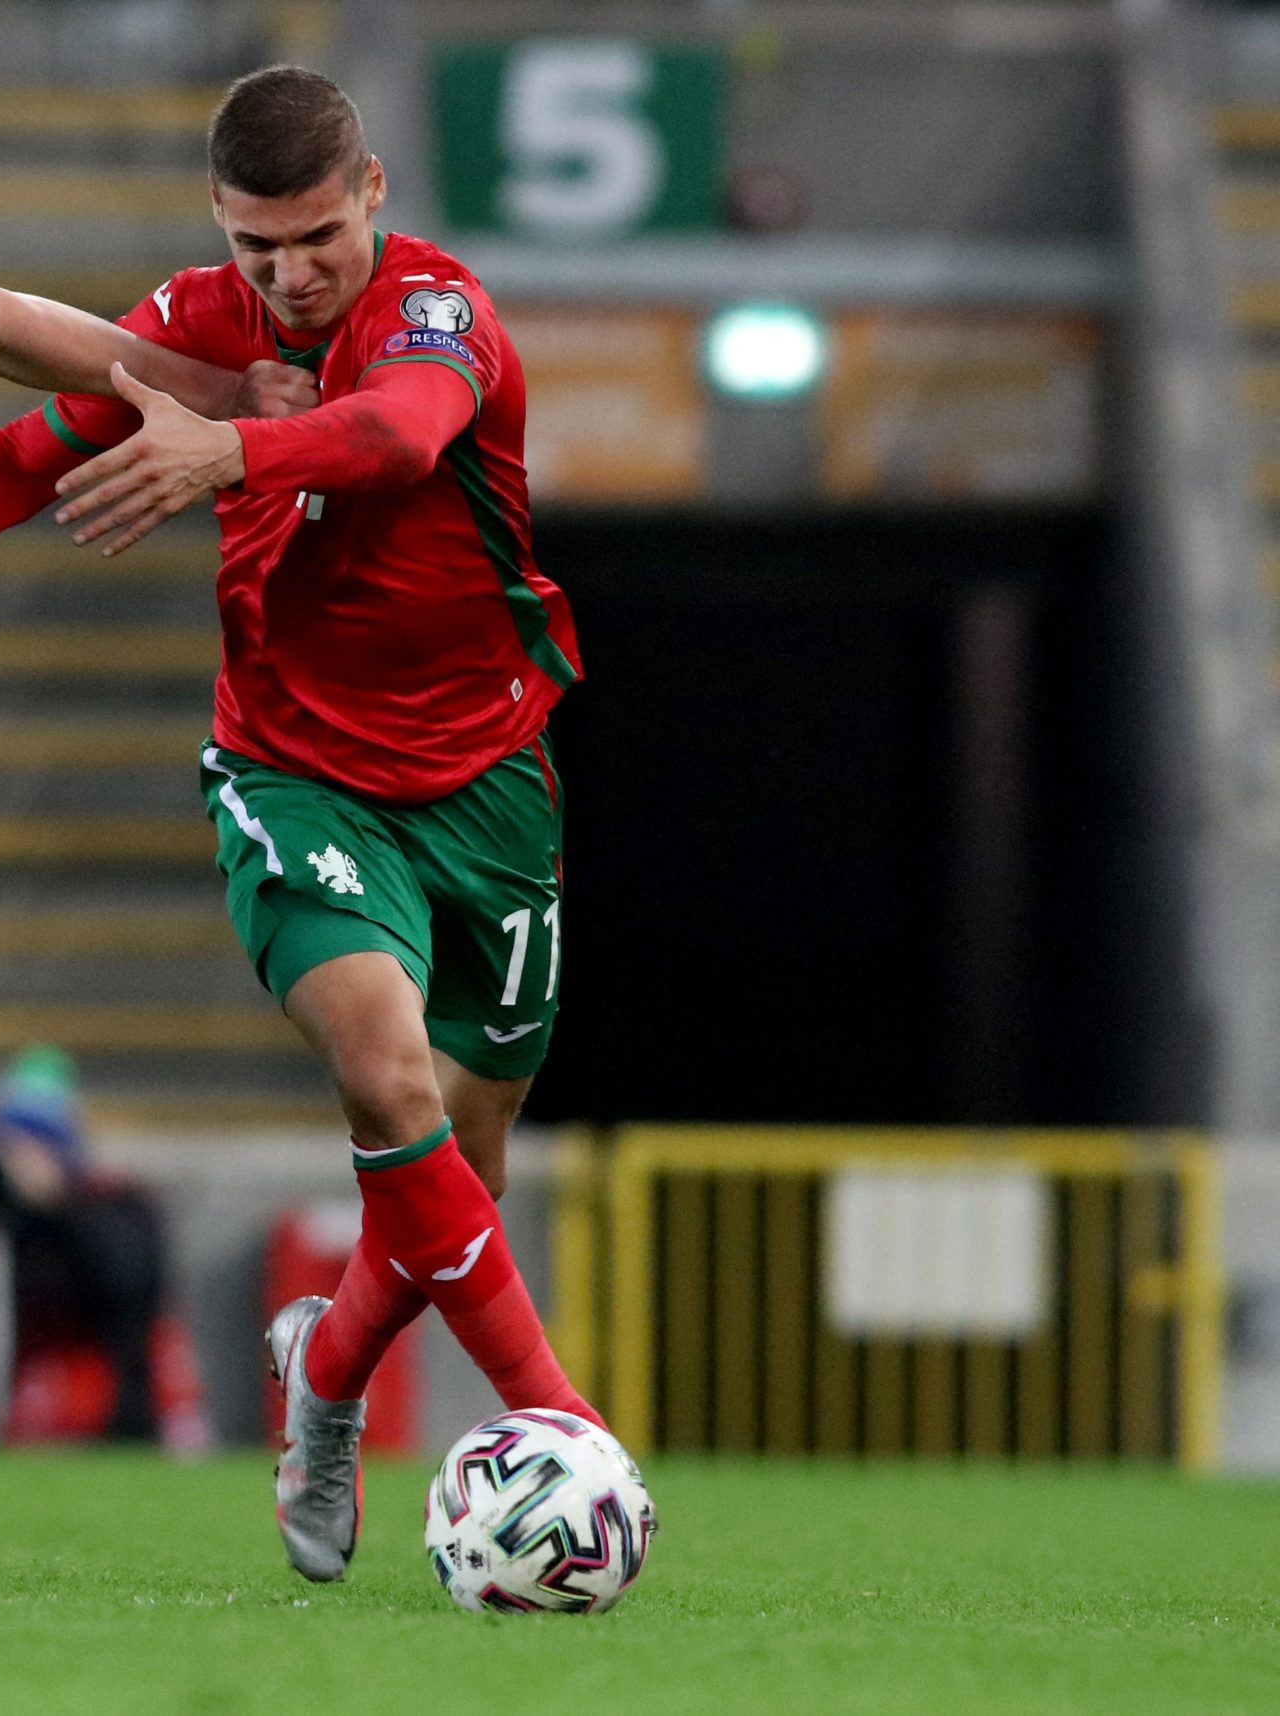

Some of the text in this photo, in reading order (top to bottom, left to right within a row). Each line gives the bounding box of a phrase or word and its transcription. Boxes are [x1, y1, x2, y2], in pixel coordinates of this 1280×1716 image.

[504, 44, 658, 222] 5
[411, 332, 473, 362] RESPECT
[499, 899, 560, 1006] 11
